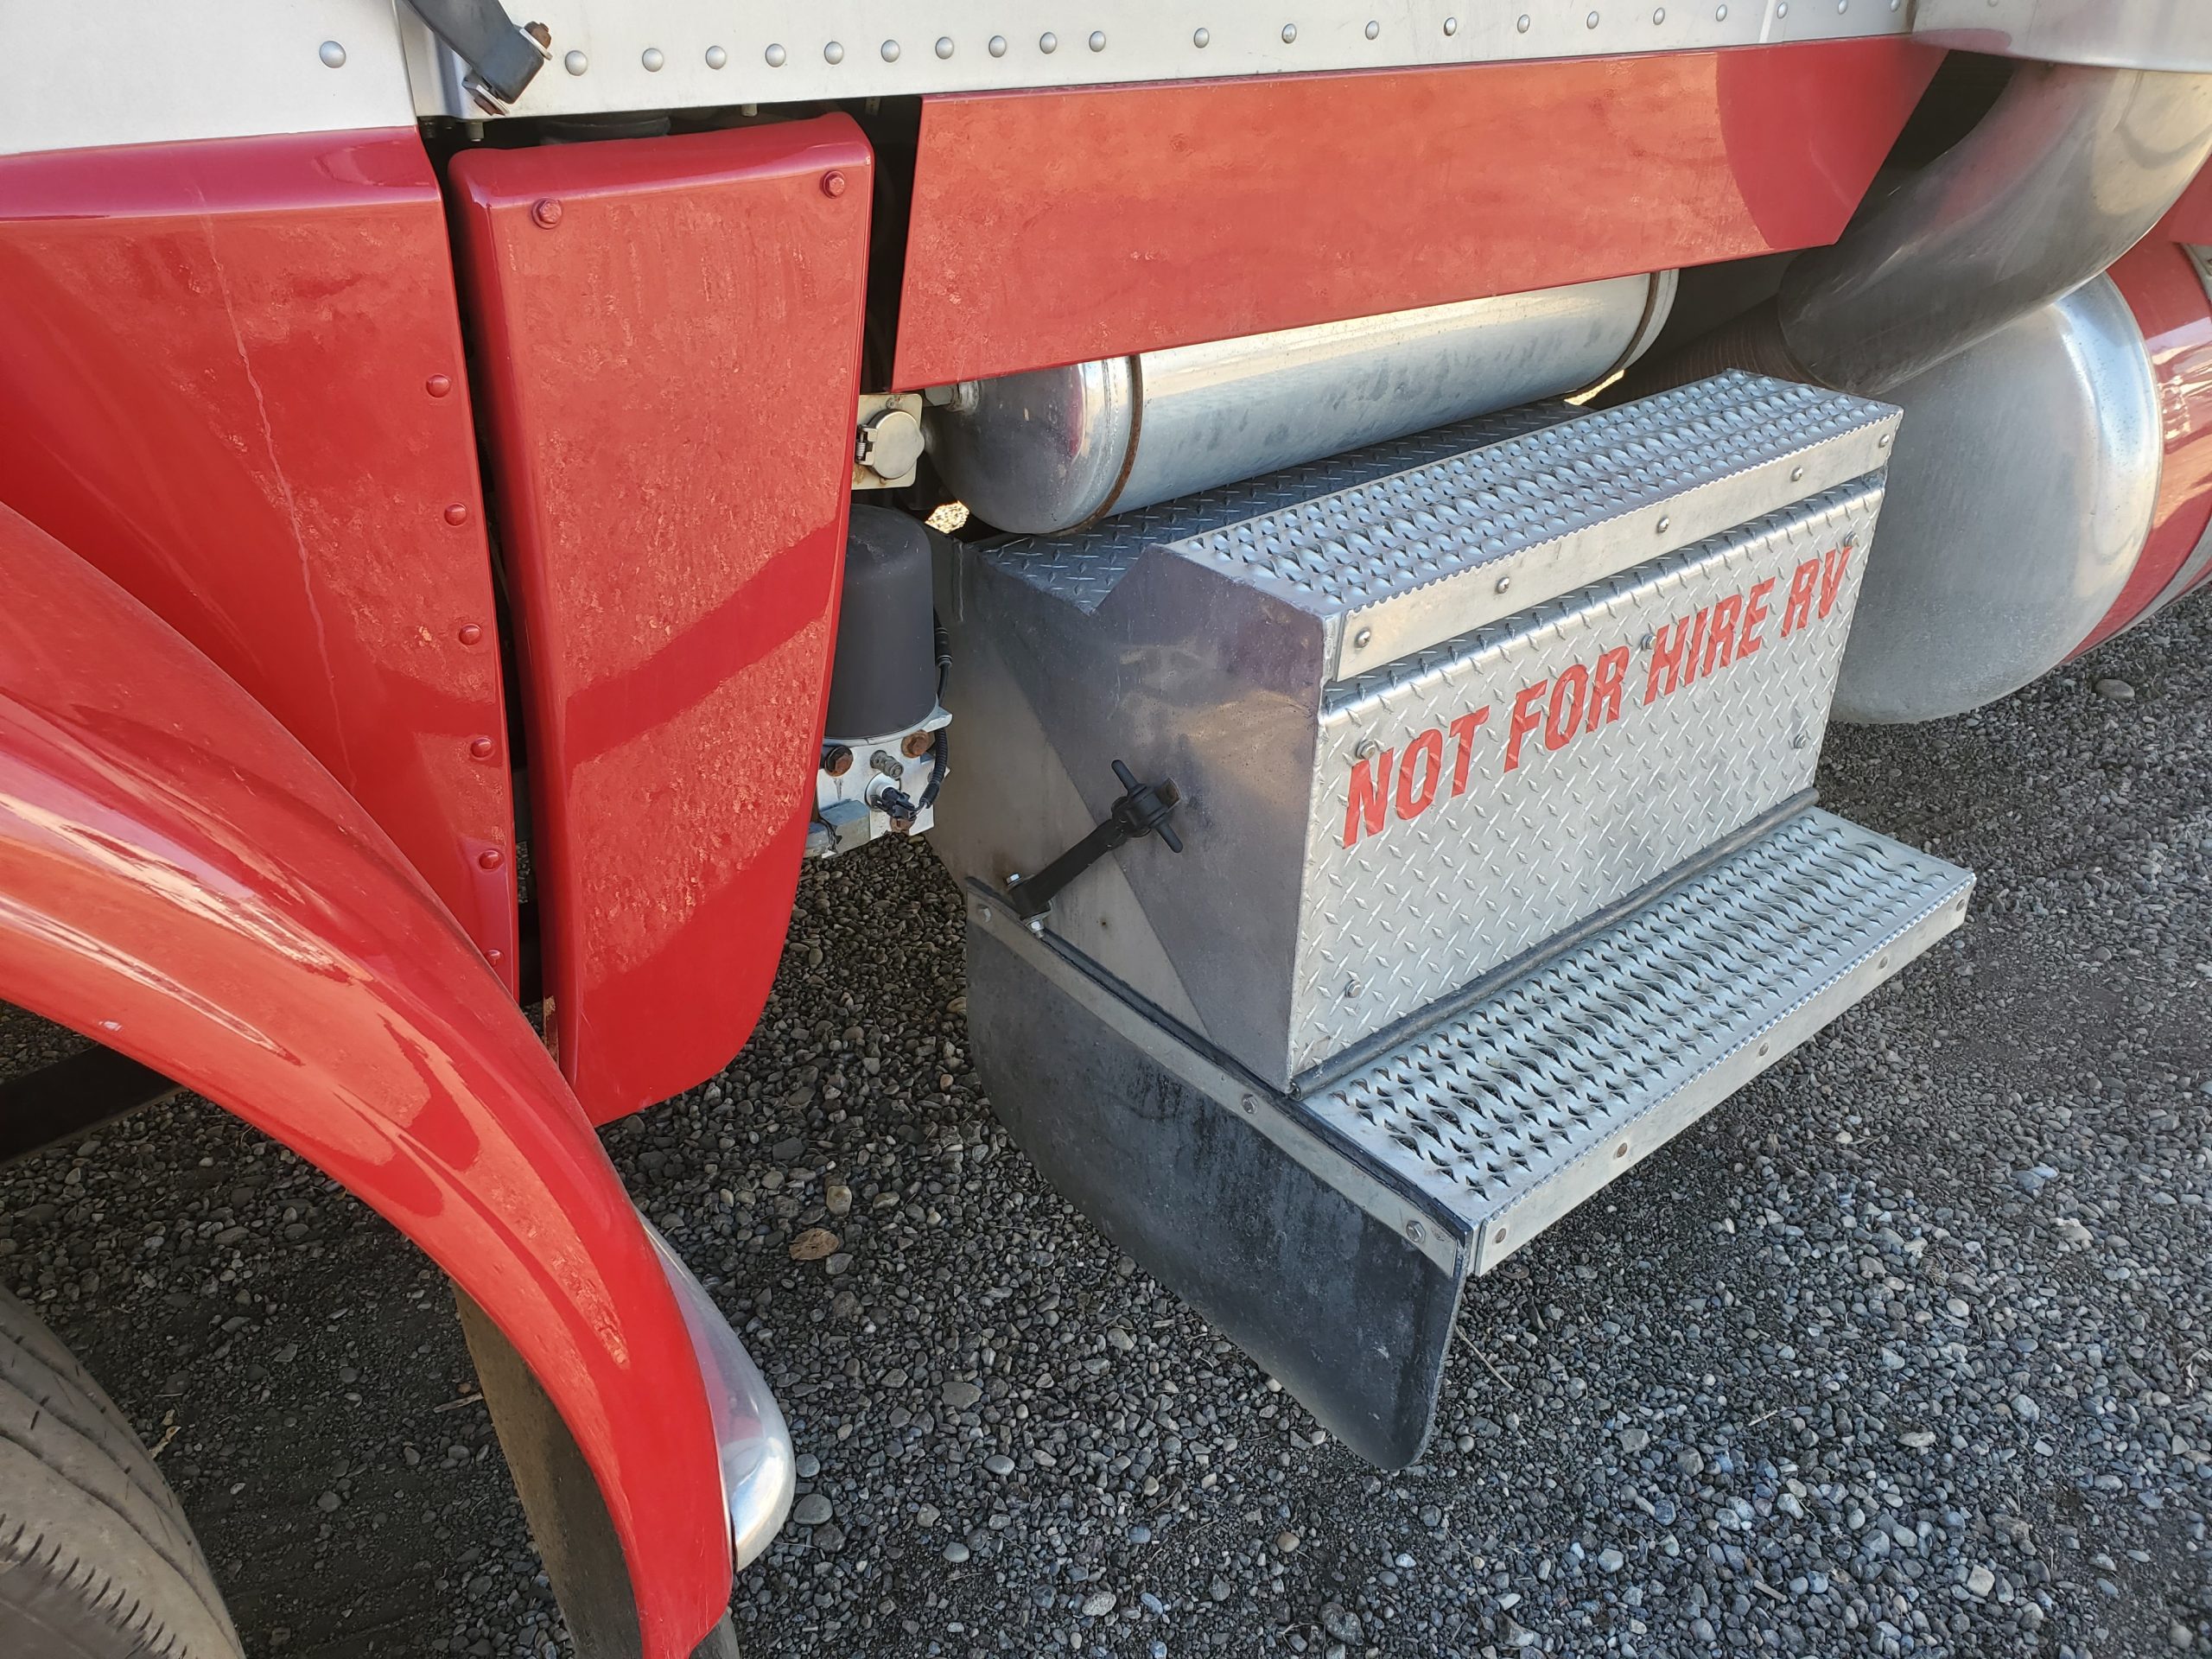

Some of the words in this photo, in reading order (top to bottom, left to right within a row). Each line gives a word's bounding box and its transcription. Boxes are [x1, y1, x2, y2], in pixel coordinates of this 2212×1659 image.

[1342, 705, 1491, 849] NOT
[1503, 645, 1630, 773] FOR
[1643, 576, 1776, 706] HIRE
[1780, 546, 1852, 638] RV
